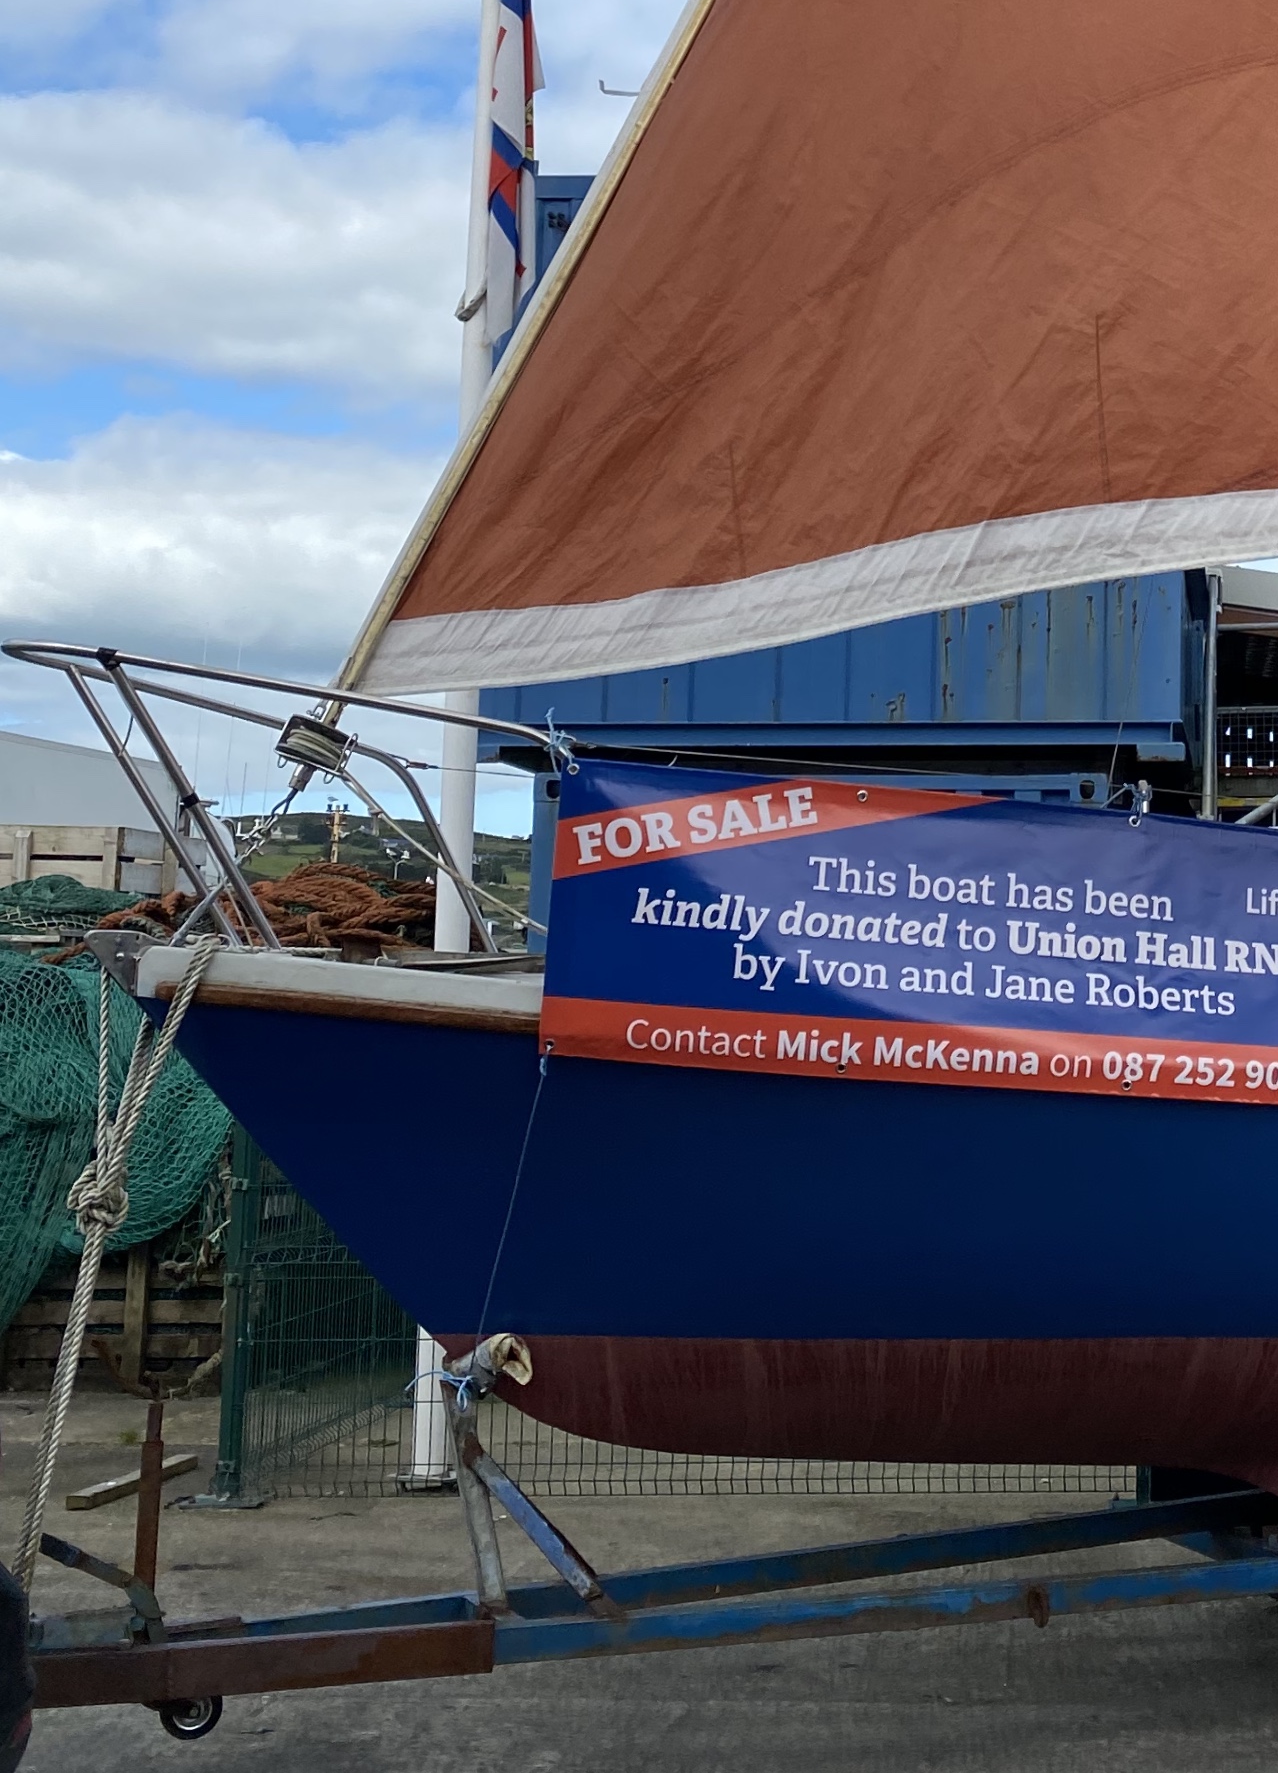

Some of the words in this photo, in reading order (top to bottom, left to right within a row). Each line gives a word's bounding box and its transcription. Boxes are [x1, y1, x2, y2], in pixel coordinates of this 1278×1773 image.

[572, 811, 681, 865] FOR
[687, 786, 818, 844] SALE
[808, 856, 897, 897] This
[907, 864, 995, 906] boat
[1005, 873, 1074, 912] has
[1084, 879, 1173, 922] been
[631, 887, 770, 941] kindly
[778, 900, 948, 948] donated
[956, 918, 996, 952] to
[1006, 920, 1127, 963] Union
[1134, 930, 1217, 971] Hall
[733, 943, 786, 991] by
[794, 949, 889, 990] Ivon
[899, 961, 975, 996] and
[985, 964, 1075, 1004] Jane
[1085, 972, 1236, 1016] Roberts
[626, 1019, 766, 1059] Contact
[776, 1029, 863, 1065] Mick
[873, 1036, 1040, 1077] McKenna
[1050, 1053, 1091, 1079] on
[1102, 1050, 1165, 1082] 087
[1174, 1055, 1235, 1088] 252
